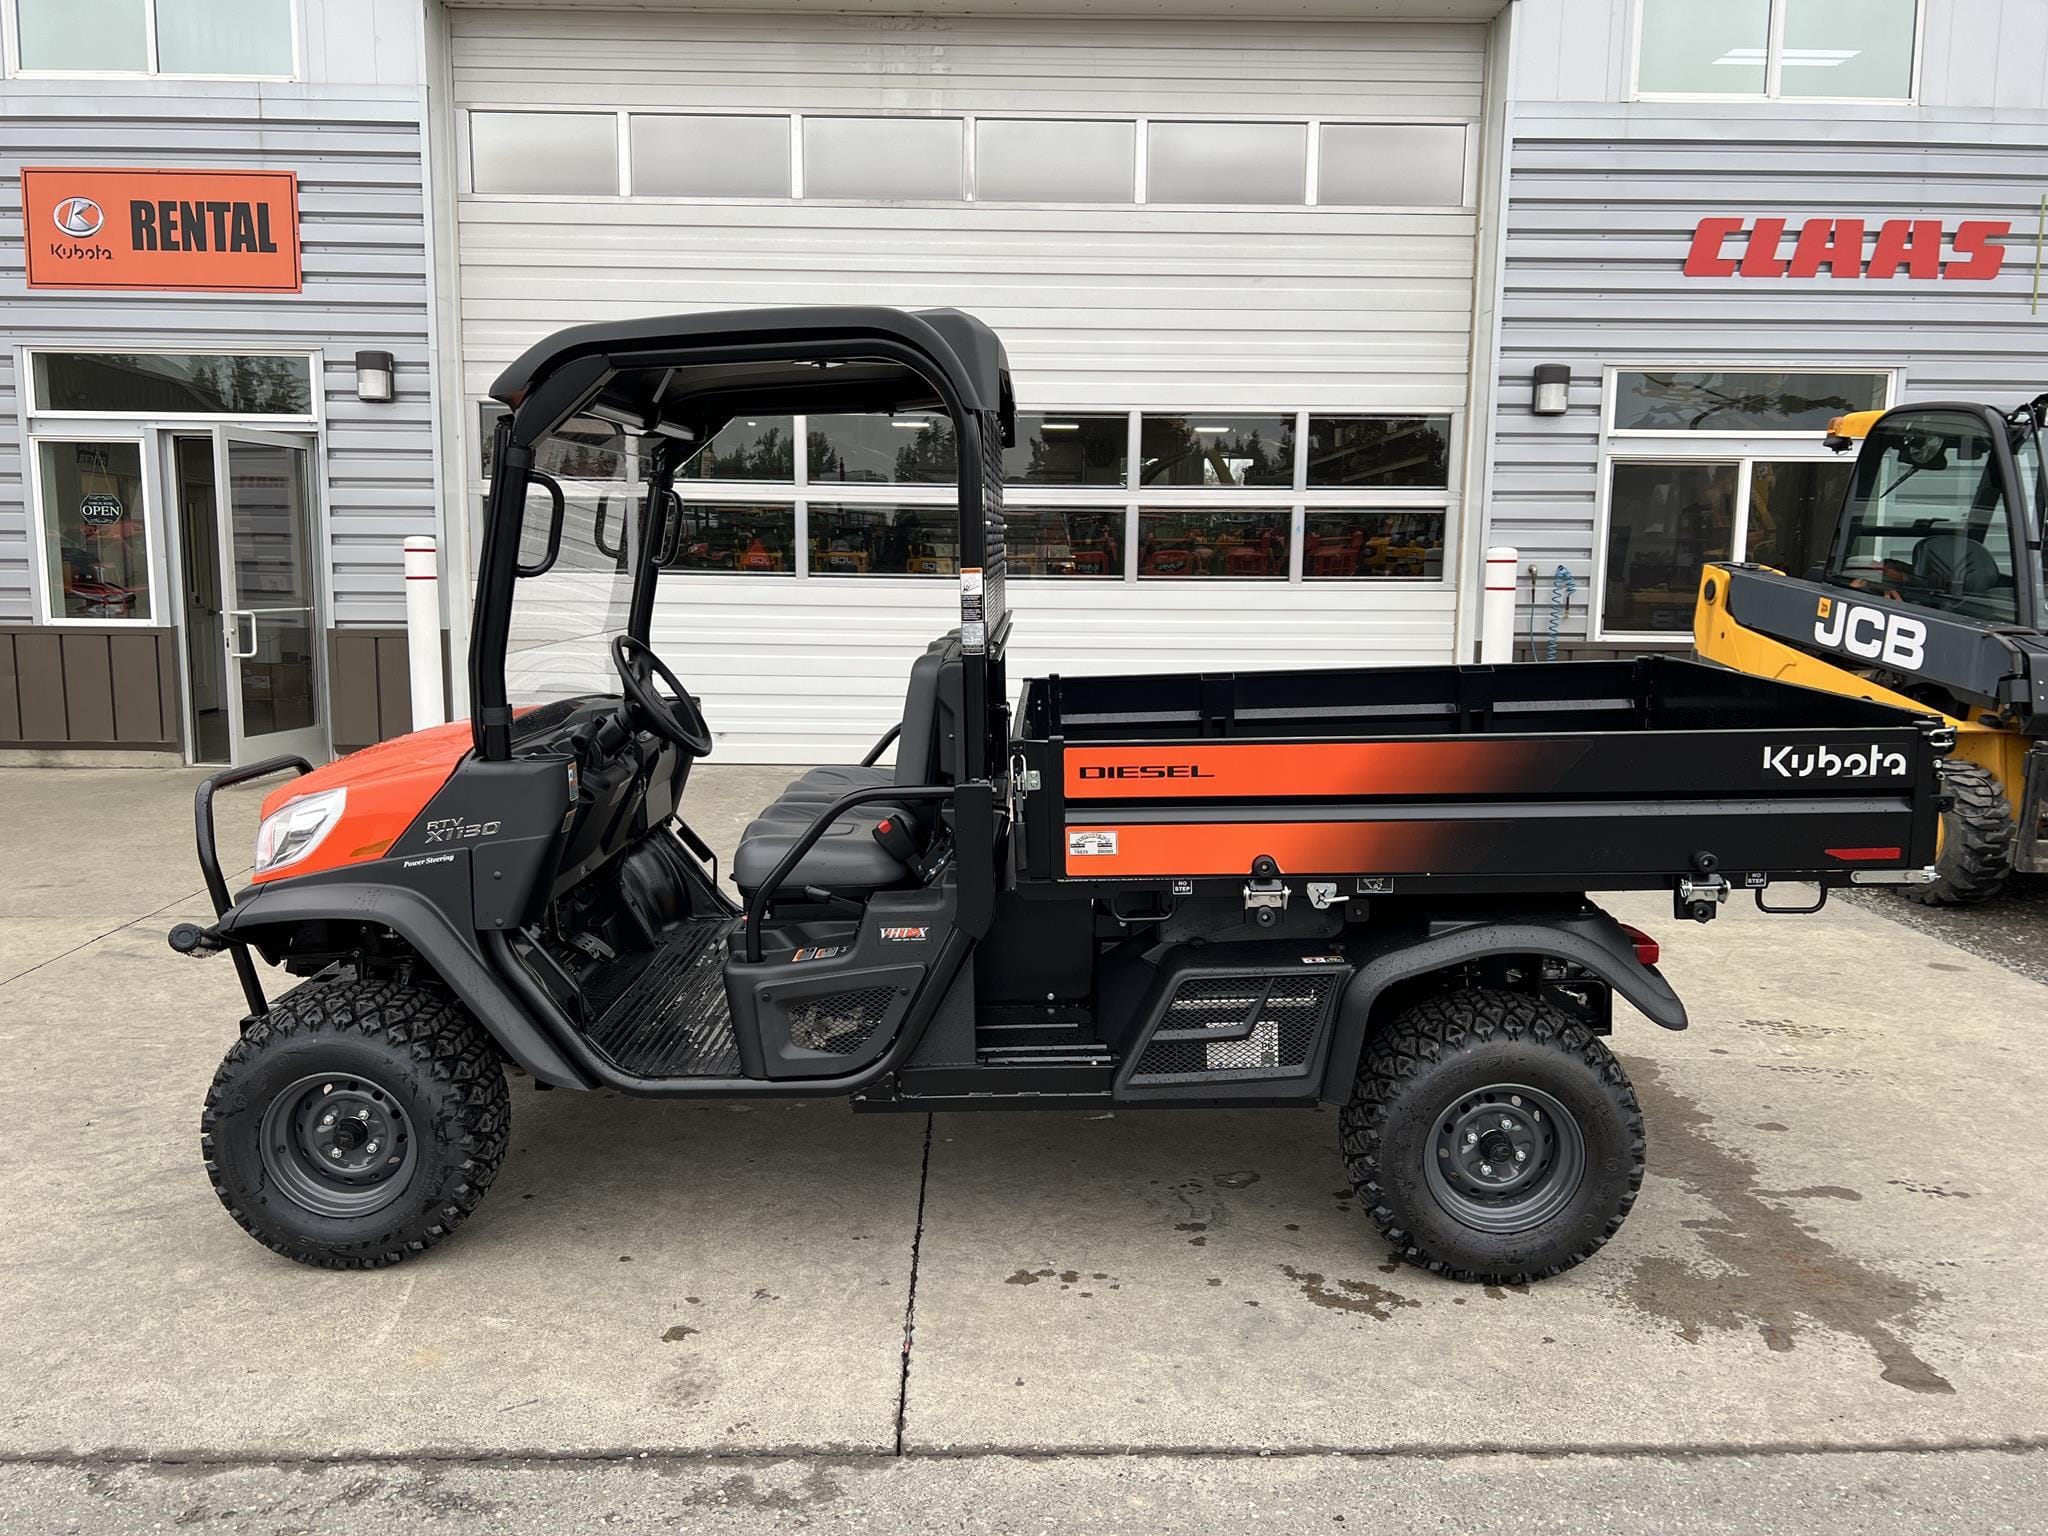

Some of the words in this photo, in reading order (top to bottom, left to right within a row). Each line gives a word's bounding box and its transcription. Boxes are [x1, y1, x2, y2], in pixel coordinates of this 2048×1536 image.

[129, 199, 278, 254] RENTAL
[50, 243, 113, 260] Kubota
[1682, 217, 2012, 281] CLAAS
[82, 505, 120, 516] OPEN
[1814, 601, 1928, 671] JCB
[1763, 744, 1907, 777] Kubota
[1079, 765, 1216, 779] DIESEL
[424, 821, 502, 844] X1130
[426, 817, 464, 831] RTV
[403, 859, 426, 868] Power
[426, 854, 455, 864] Steering
